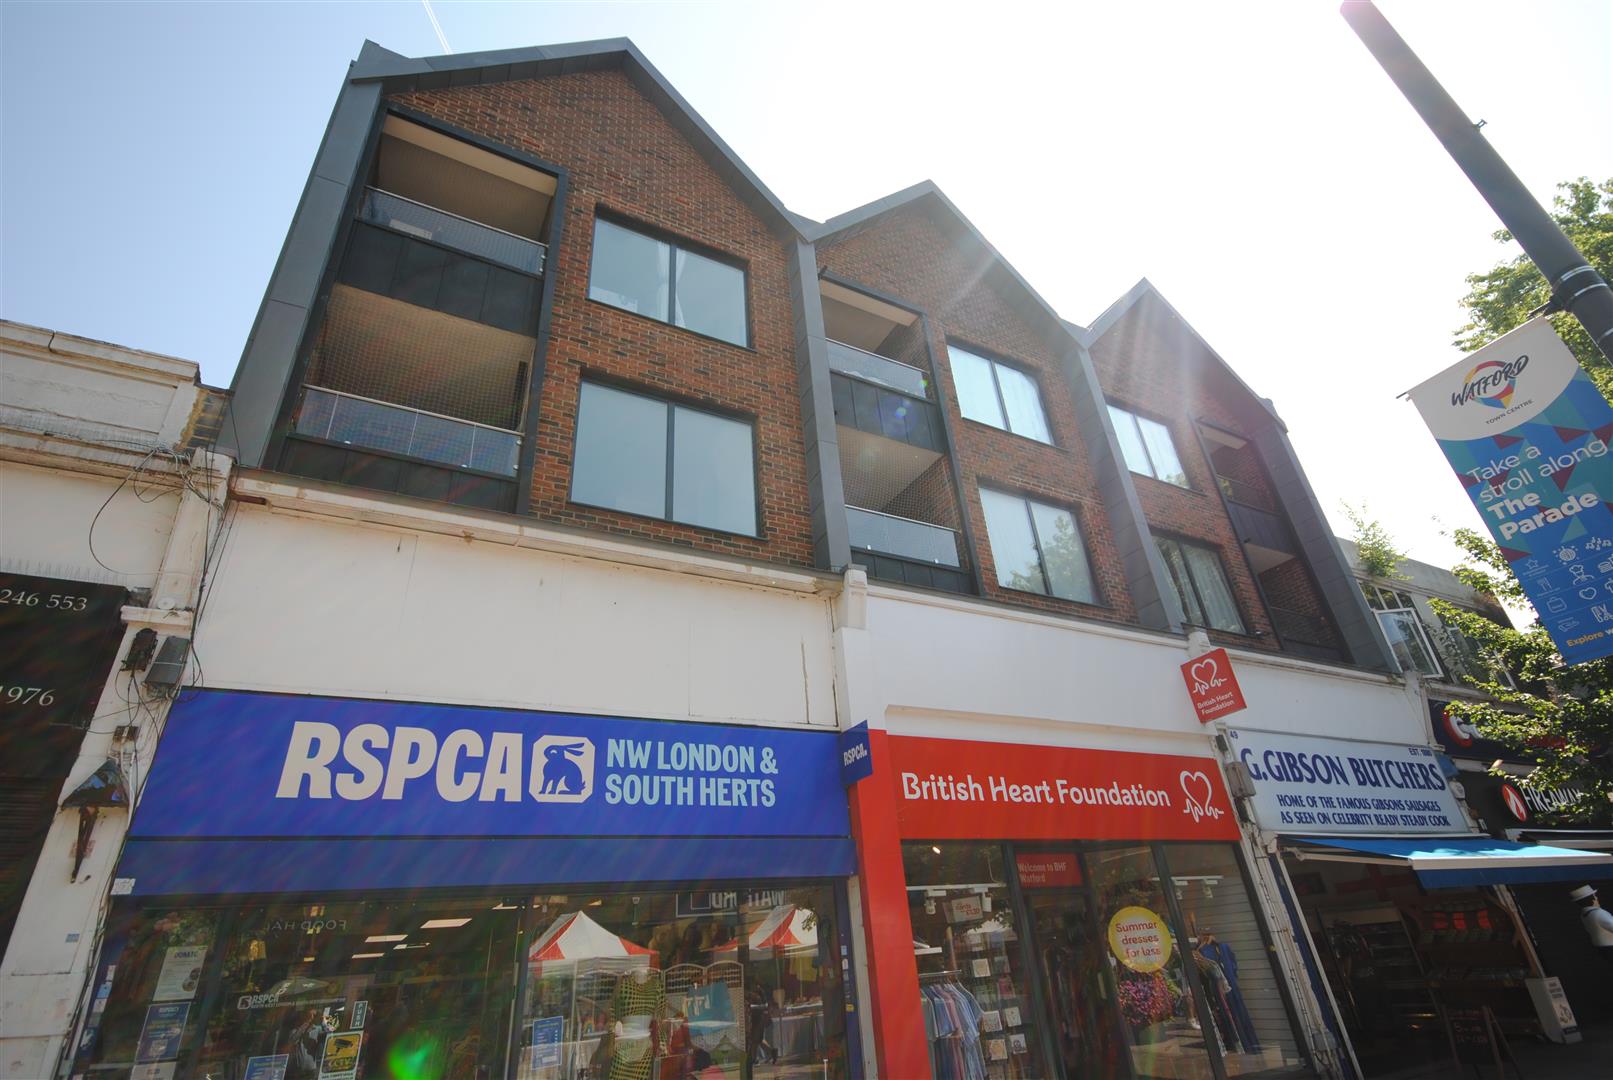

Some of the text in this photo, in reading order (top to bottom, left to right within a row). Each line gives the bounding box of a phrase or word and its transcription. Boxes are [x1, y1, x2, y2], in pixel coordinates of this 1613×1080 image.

[1451, 355, 1529, 406] WATFORD
[1486, 399, 1534, 425] TOWN CENTRE
[1467, 446, 1541, 483] Take a
[1479, 439, 1608, 503] stroll along
[1486, 492, 1541, 520] The
[1498, 493, 1599, 541] Parade
[0, 589, 88, 611] 246 553
[1567, 631, 1604, 648] Explore
[1197, 692, 1234, 709] British Heart
[1201, 700, 1236, 715] Foundation
[275, 720, 524, 803] RSPCA
[607, 738, 779, 774] NW LONDON &
[1347, 757, 1446, 791] BUTCHERS
[605, 773, 777, 808] SOUTH HERTS
[901, 772, 1171, 808] British Heart Foundation
[1277, 794, 1441, 812] HOME OF THE FAMOUS GIBSONS SAUSAGES
[1280, 811, 1451, 826] AS SEEN ON CELEBRITY READY STEADY COOK
[1017, 863, 1046, 872] Welcome
[1115, 922, 1158, 932] Summer
[1121, 935, 1159, 944] dresses
[1126, 946, 1161, 957] for less
